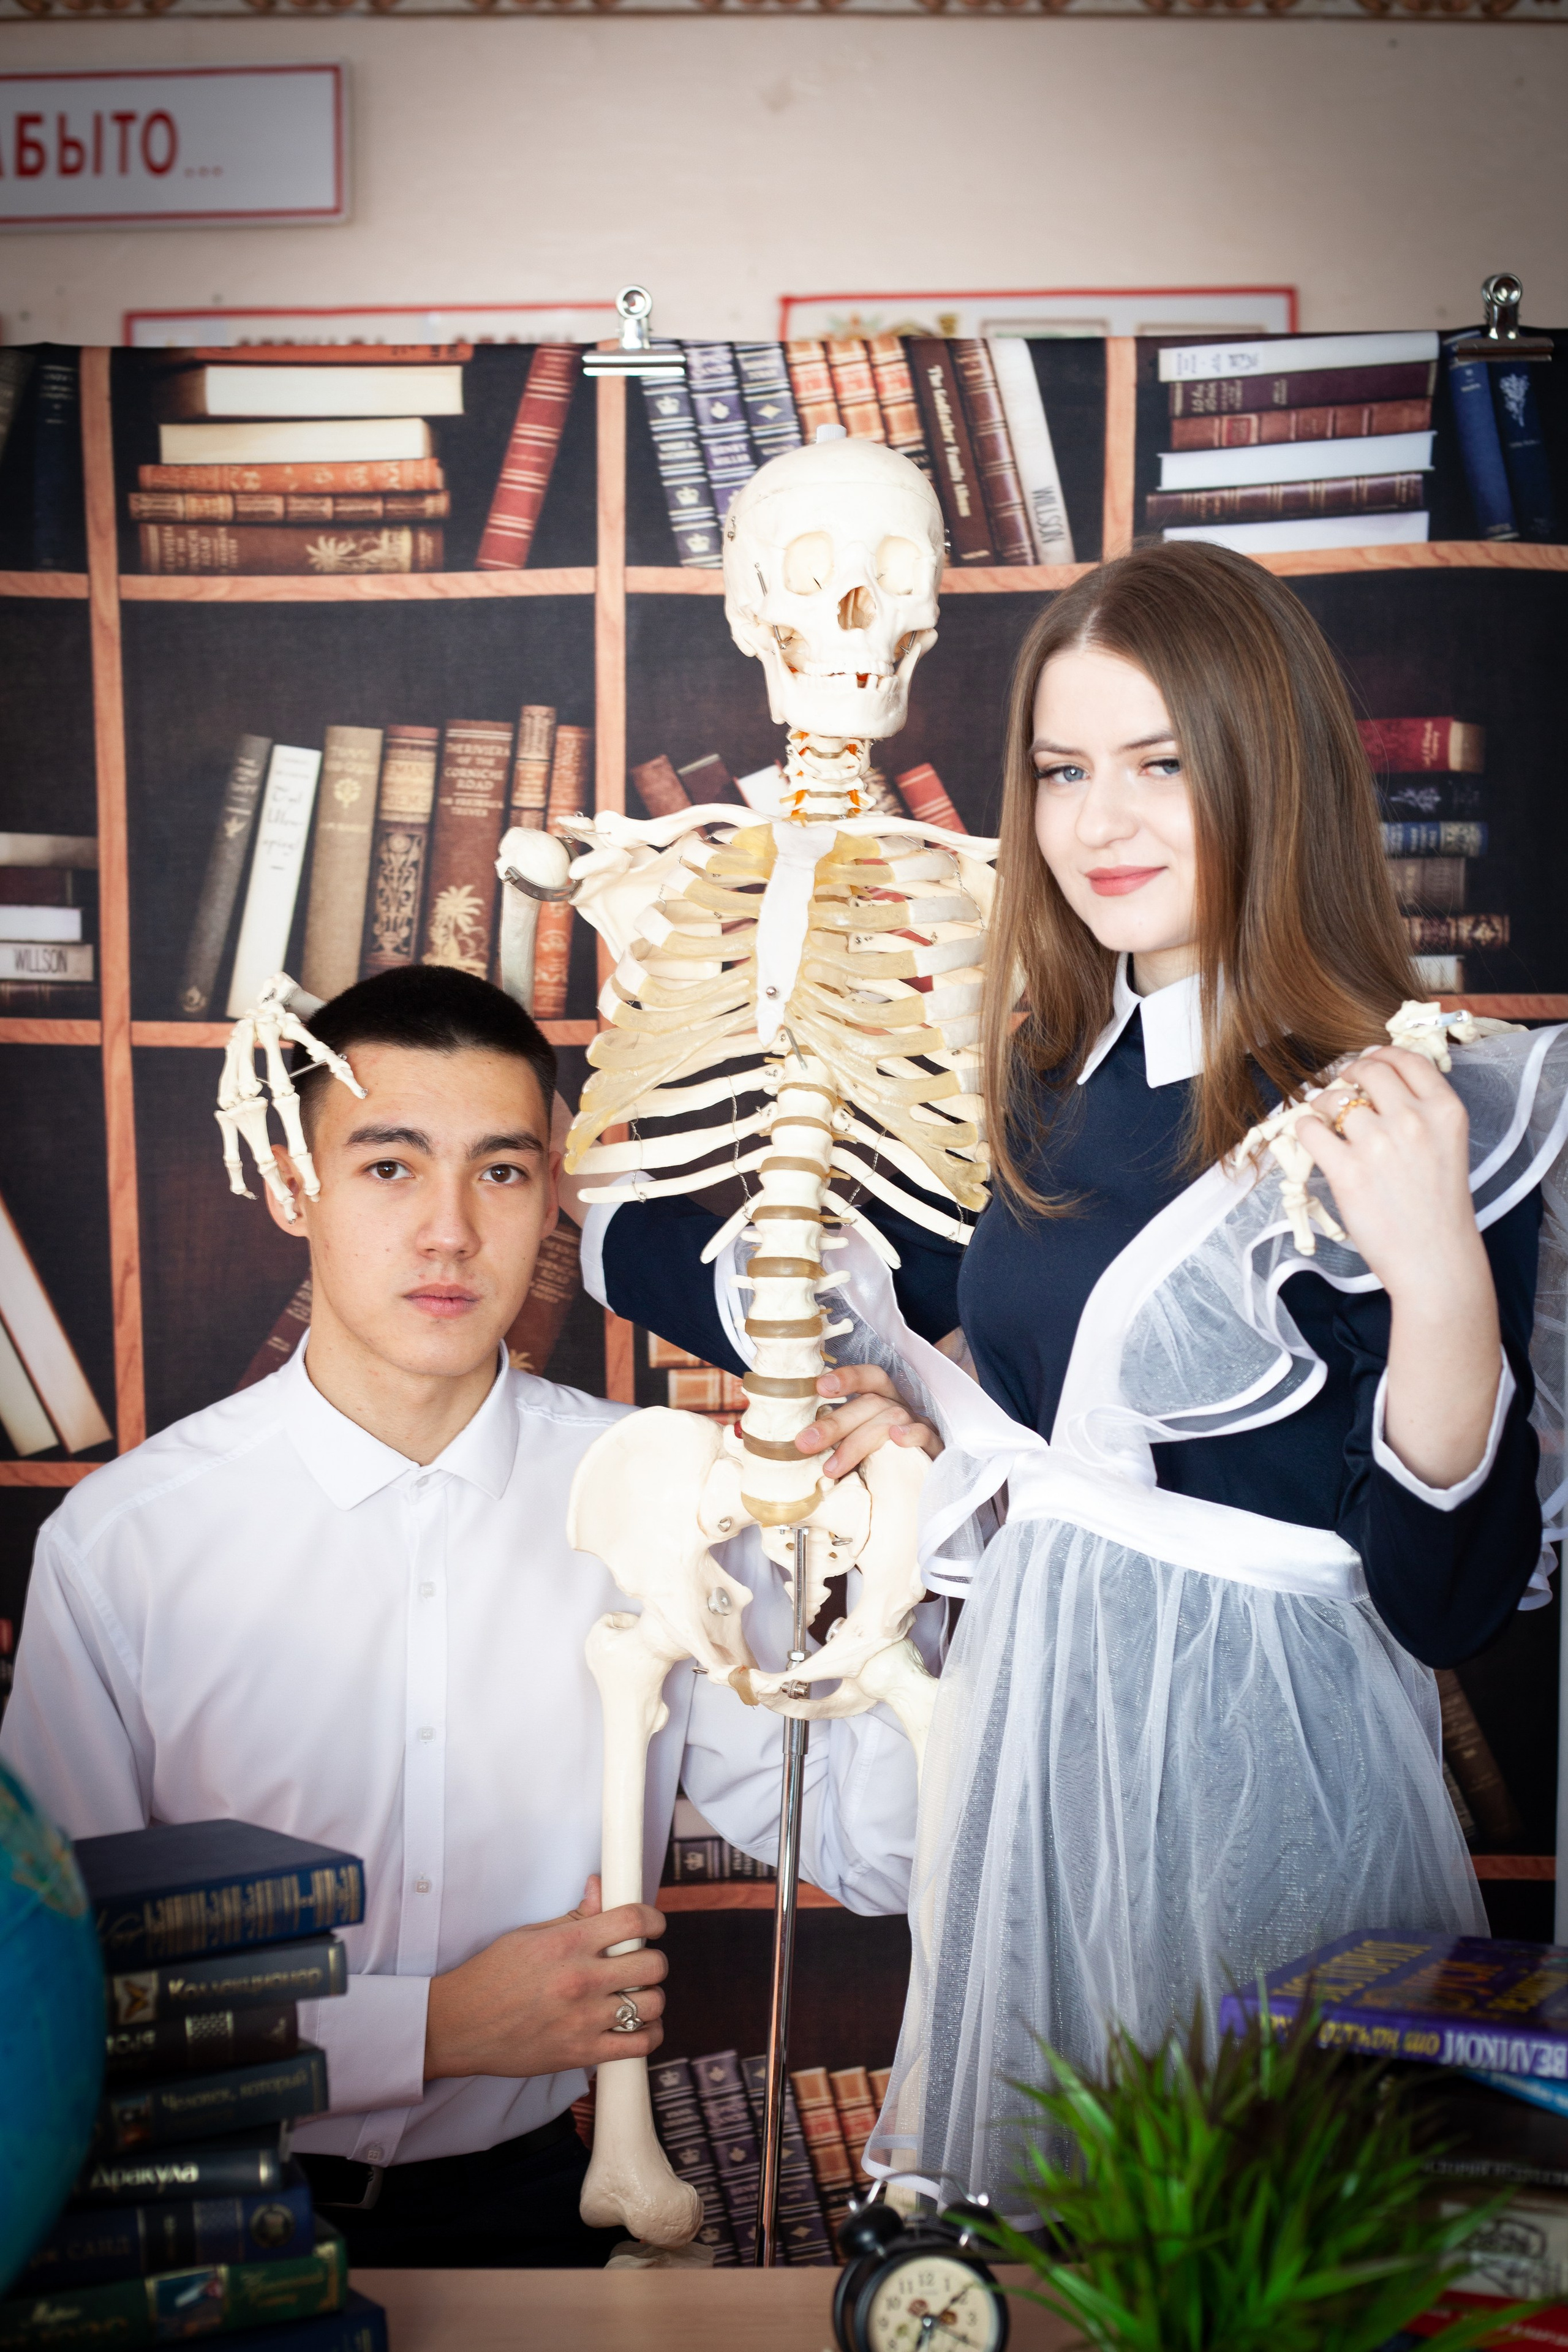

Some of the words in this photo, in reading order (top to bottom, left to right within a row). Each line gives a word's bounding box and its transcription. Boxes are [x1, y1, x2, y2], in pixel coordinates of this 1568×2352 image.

[0, 107, 223, 178] БЫТО...
[1032, 485, 1066, 544] WILLSON
[13, 948, 69, 973] WILLSON
[89, 2162, 200, 2193] Дракула
